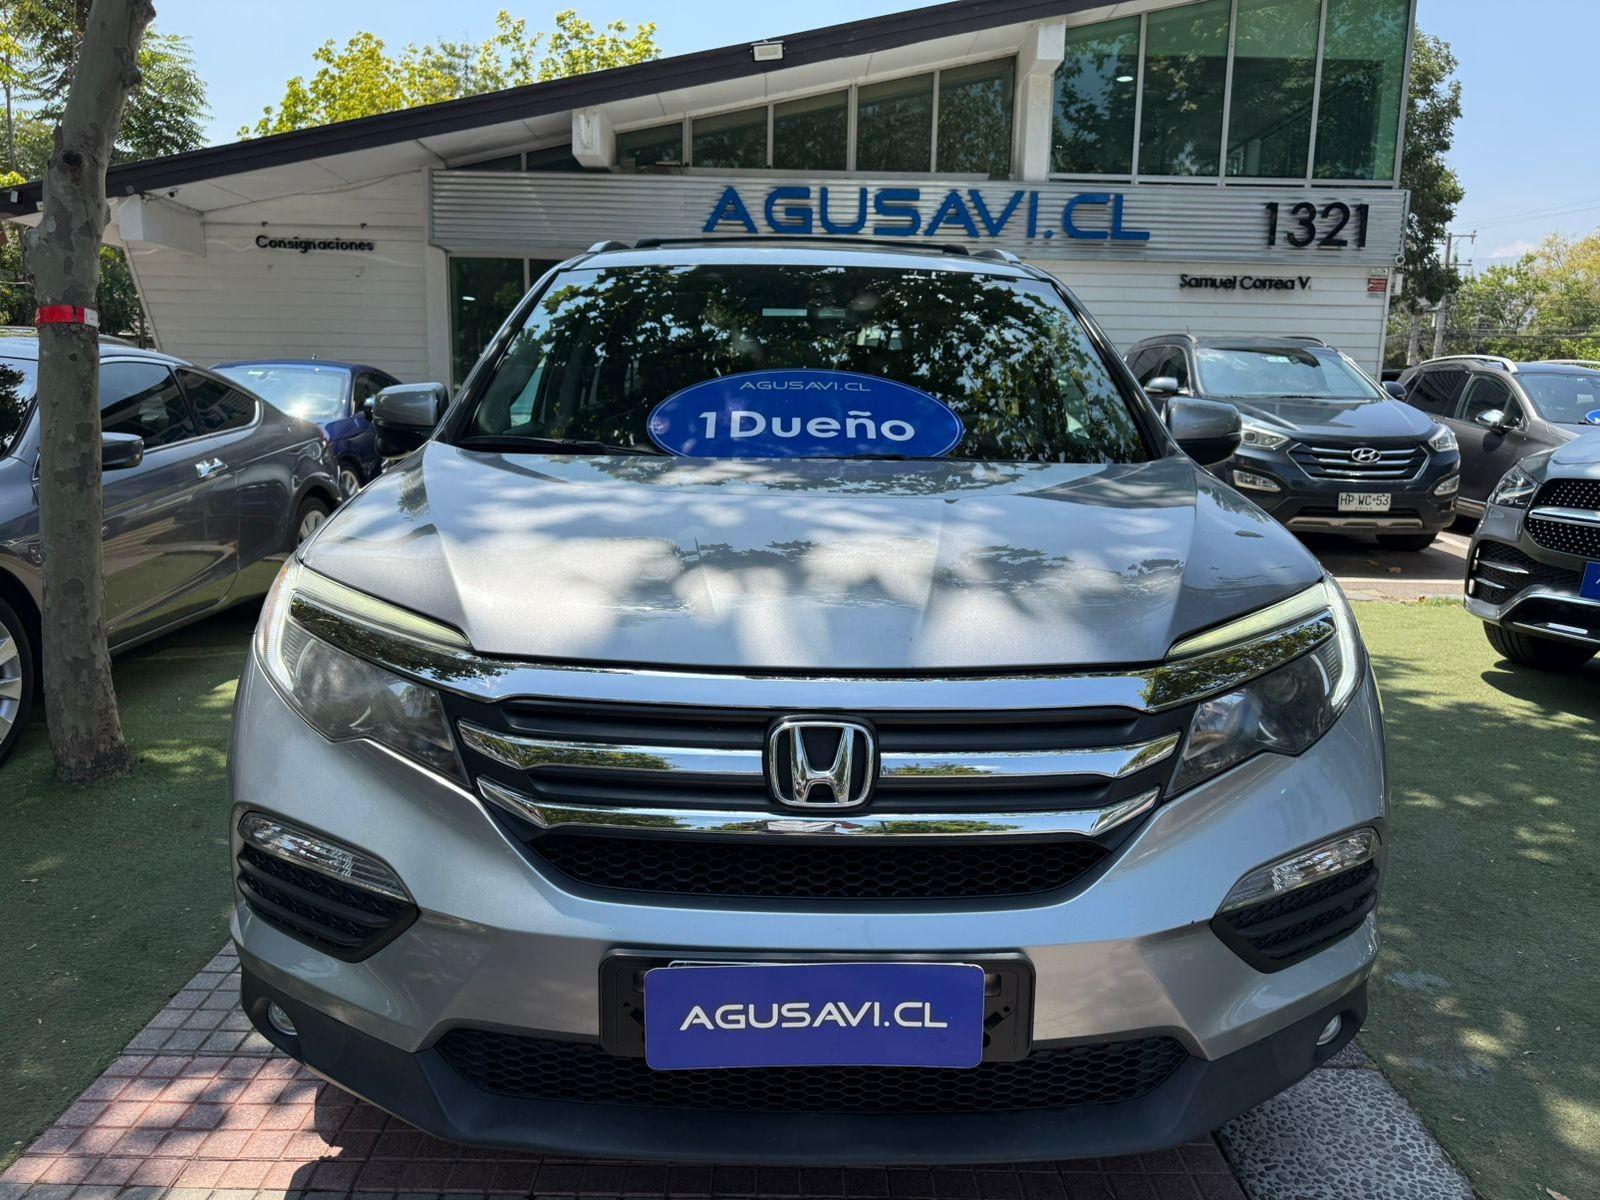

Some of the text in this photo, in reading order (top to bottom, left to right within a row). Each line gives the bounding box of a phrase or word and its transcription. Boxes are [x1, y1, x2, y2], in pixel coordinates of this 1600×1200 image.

[702, 186, 1150, 241] AGUSAVI.CL
[1265, 201, 1369, 248] 1321
[256, 235, 374, 253] Consignaciones
[1180, 274, 1236, 289] Samuel
[1240, 275, 1295, 290] Correa
[740, 381, 871, 392] AGUSAVI.CL
[699, 410, 915, 442] 1 Dueño
[678, 1001, 948, 1031] AGUSAVI.CL
